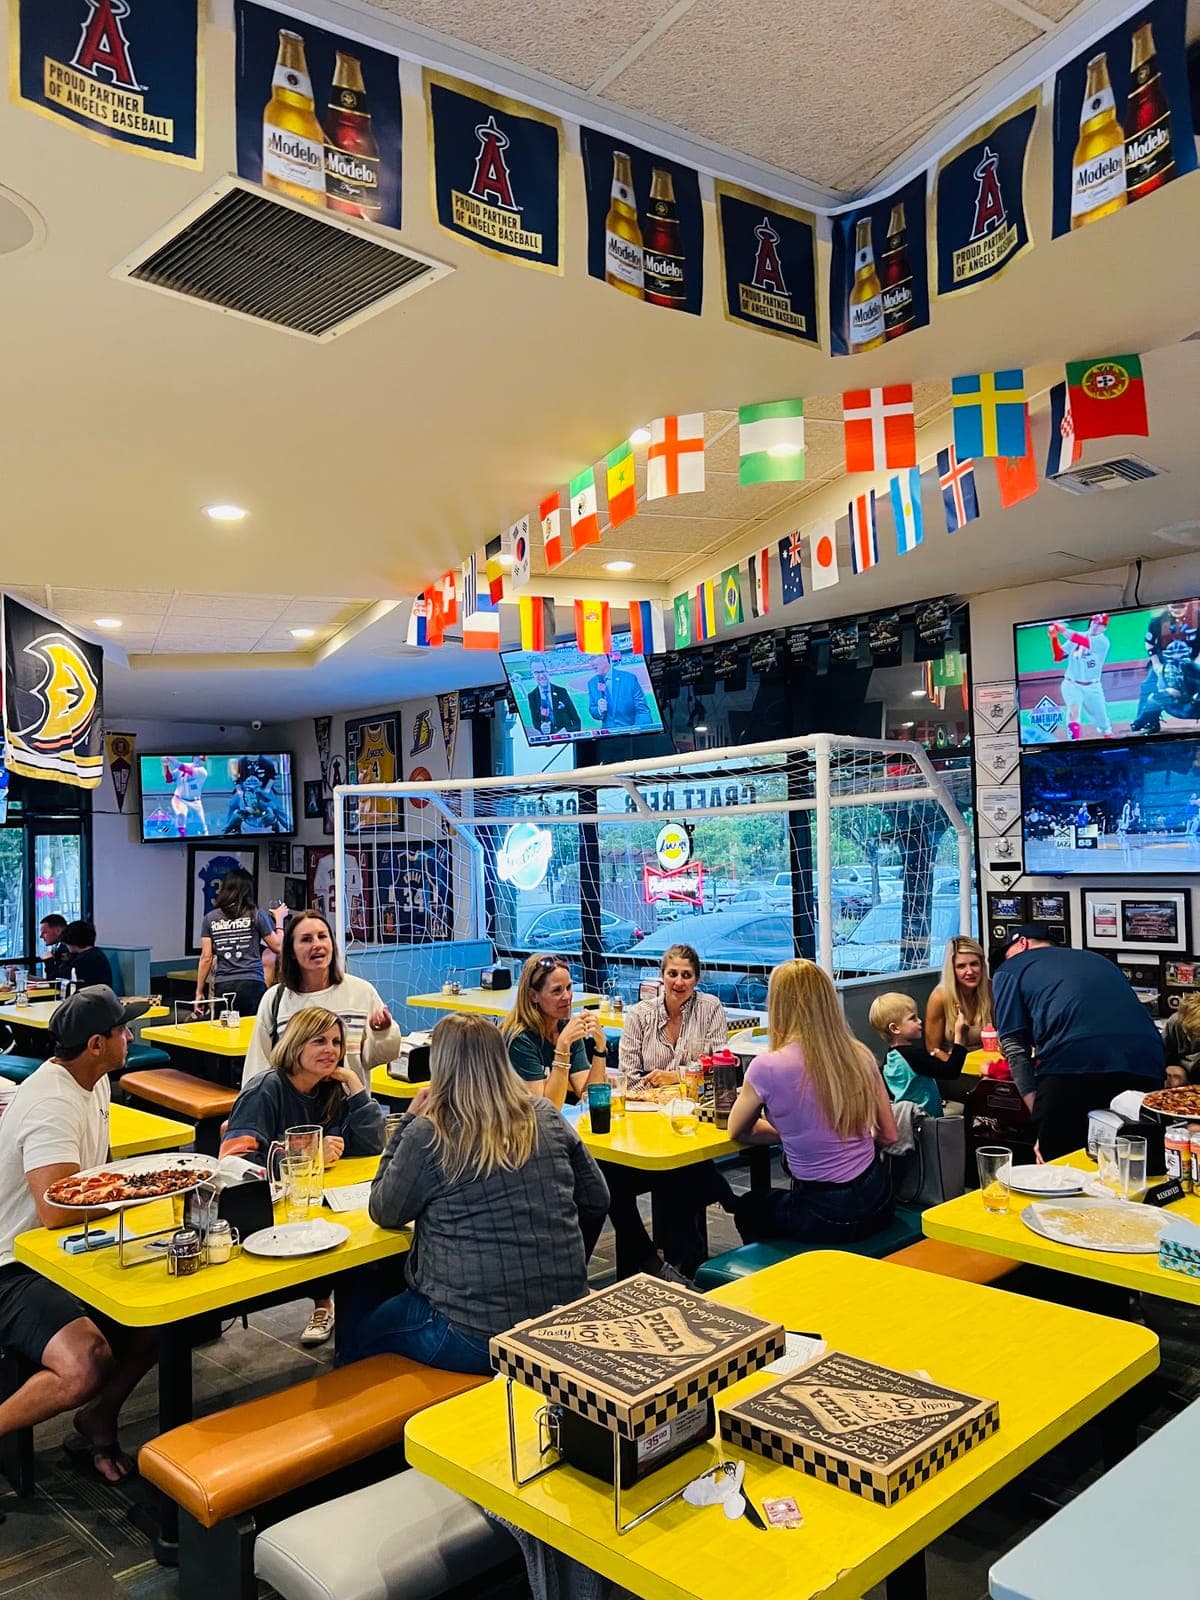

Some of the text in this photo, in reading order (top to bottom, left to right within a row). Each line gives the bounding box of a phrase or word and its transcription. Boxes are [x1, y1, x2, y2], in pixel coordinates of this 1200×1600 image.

[49, 63, 139, 113] PROUD PARTNER
[48, 81, 169, 136] OF ANGELS BASEBALL
[271, 132, 318, 165] Modelo
[1128, 128, 1167, 163] Modelo
[328, 152, 374, 183] Modelo
[1079, 157, 1120, 187] Modelo
[455, 195, 517, 229] PROUD PARTNER
[455, 208, 538, 249] OF ANGELS BASEBALL
[609, 237, 640, 266] Modelo
[956, 245, 981, 265] PROUD
[956, 252, 996, 278] OF ANGELS
[646, 254, 680, 278] Modelo
[883, 287, 911, 307] Modelo
[1030, 713, 1063, 724] AMERICA
[1156, 1186, 1180, 1201] RESERVED
[601, 1293, 641, 1315] bacon
[633, 1280, 697, 1309] oregano
[538, 1327, 572, 1339] Tasty
[552, 1313, 585, 1325] basil
[643, 1312, 685, 1352] PIZZA
[579, 1324, 600, 1343] HOT
[613, 1318, 656, 1349] Fresh
[566, 1342, 618, 1369] mushroom
[862, 1374, 920, 1398] mushroom
[810, 1389, 860, 1427] PIZZA
[891, 1397, 919, 1416] HOT
[809, 1430, 889, 1462] oregano
[866, 1427, 915, 1448] bacon
